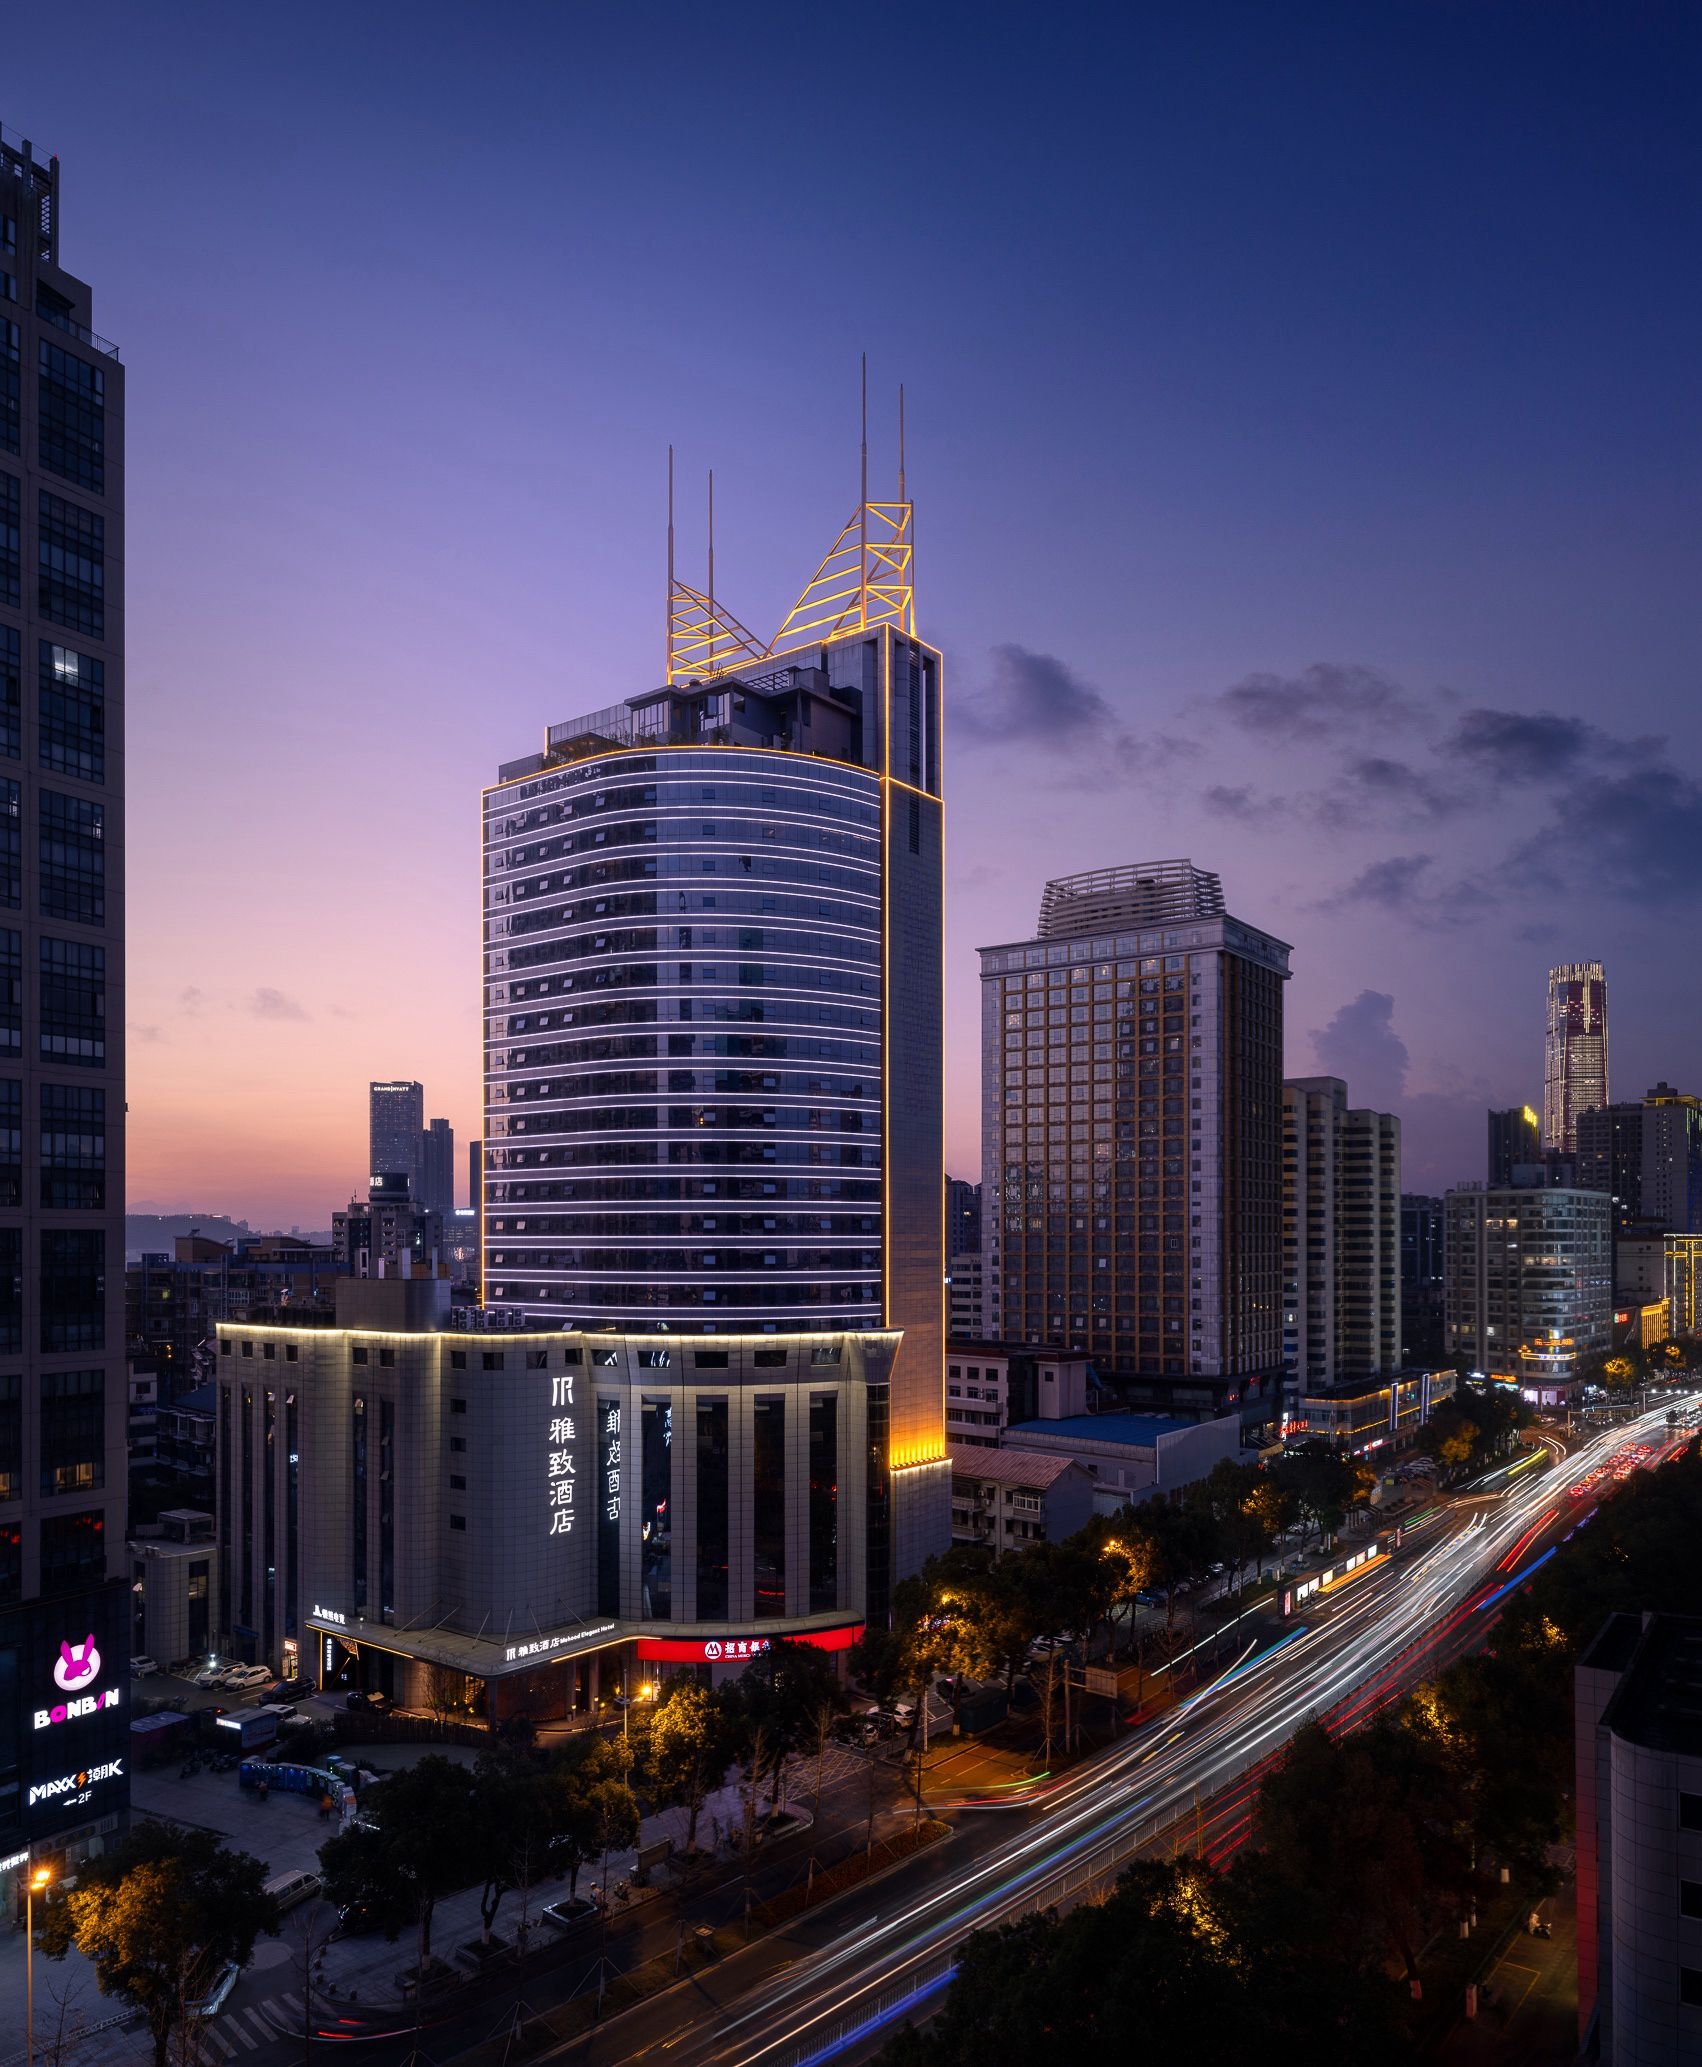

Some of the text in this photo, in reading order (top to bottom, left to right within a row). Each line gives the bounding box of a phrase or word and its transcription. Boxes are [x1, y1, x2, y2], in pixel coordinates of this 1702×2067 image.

[548, 1417, 576, 1535] 雅致酒店
[518, 1637, 559, 1657] 雅致酒店
[600, 1623, 615, 1632] Hotel
[29, 1774, 77, 1806] MAXX
[78, 1790, 92, 1804] 2F
